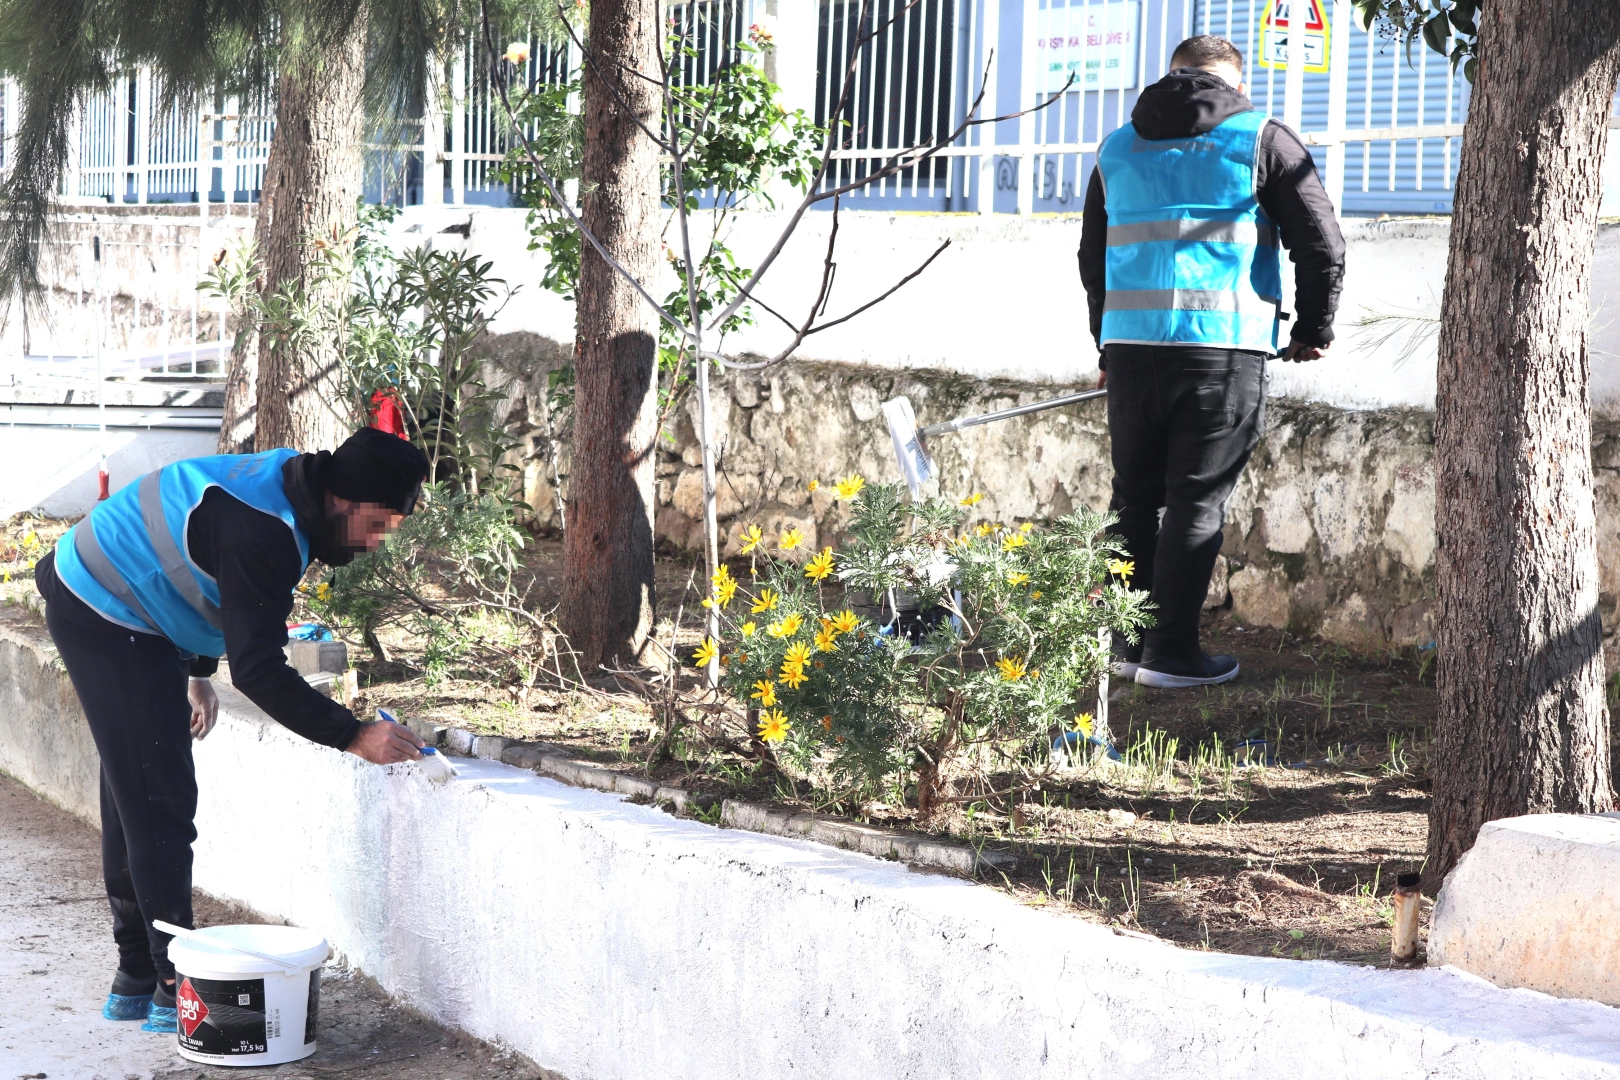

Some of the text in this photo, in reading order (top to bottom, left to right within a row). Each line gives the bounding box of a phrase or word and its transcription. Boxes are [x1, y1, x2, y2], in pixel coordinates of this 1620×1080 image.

[188, 1038, 203, 1046] TAVAN
[240, 1044, 254, 1053] 17,5
[255, 1043, 264, 1052] kg
